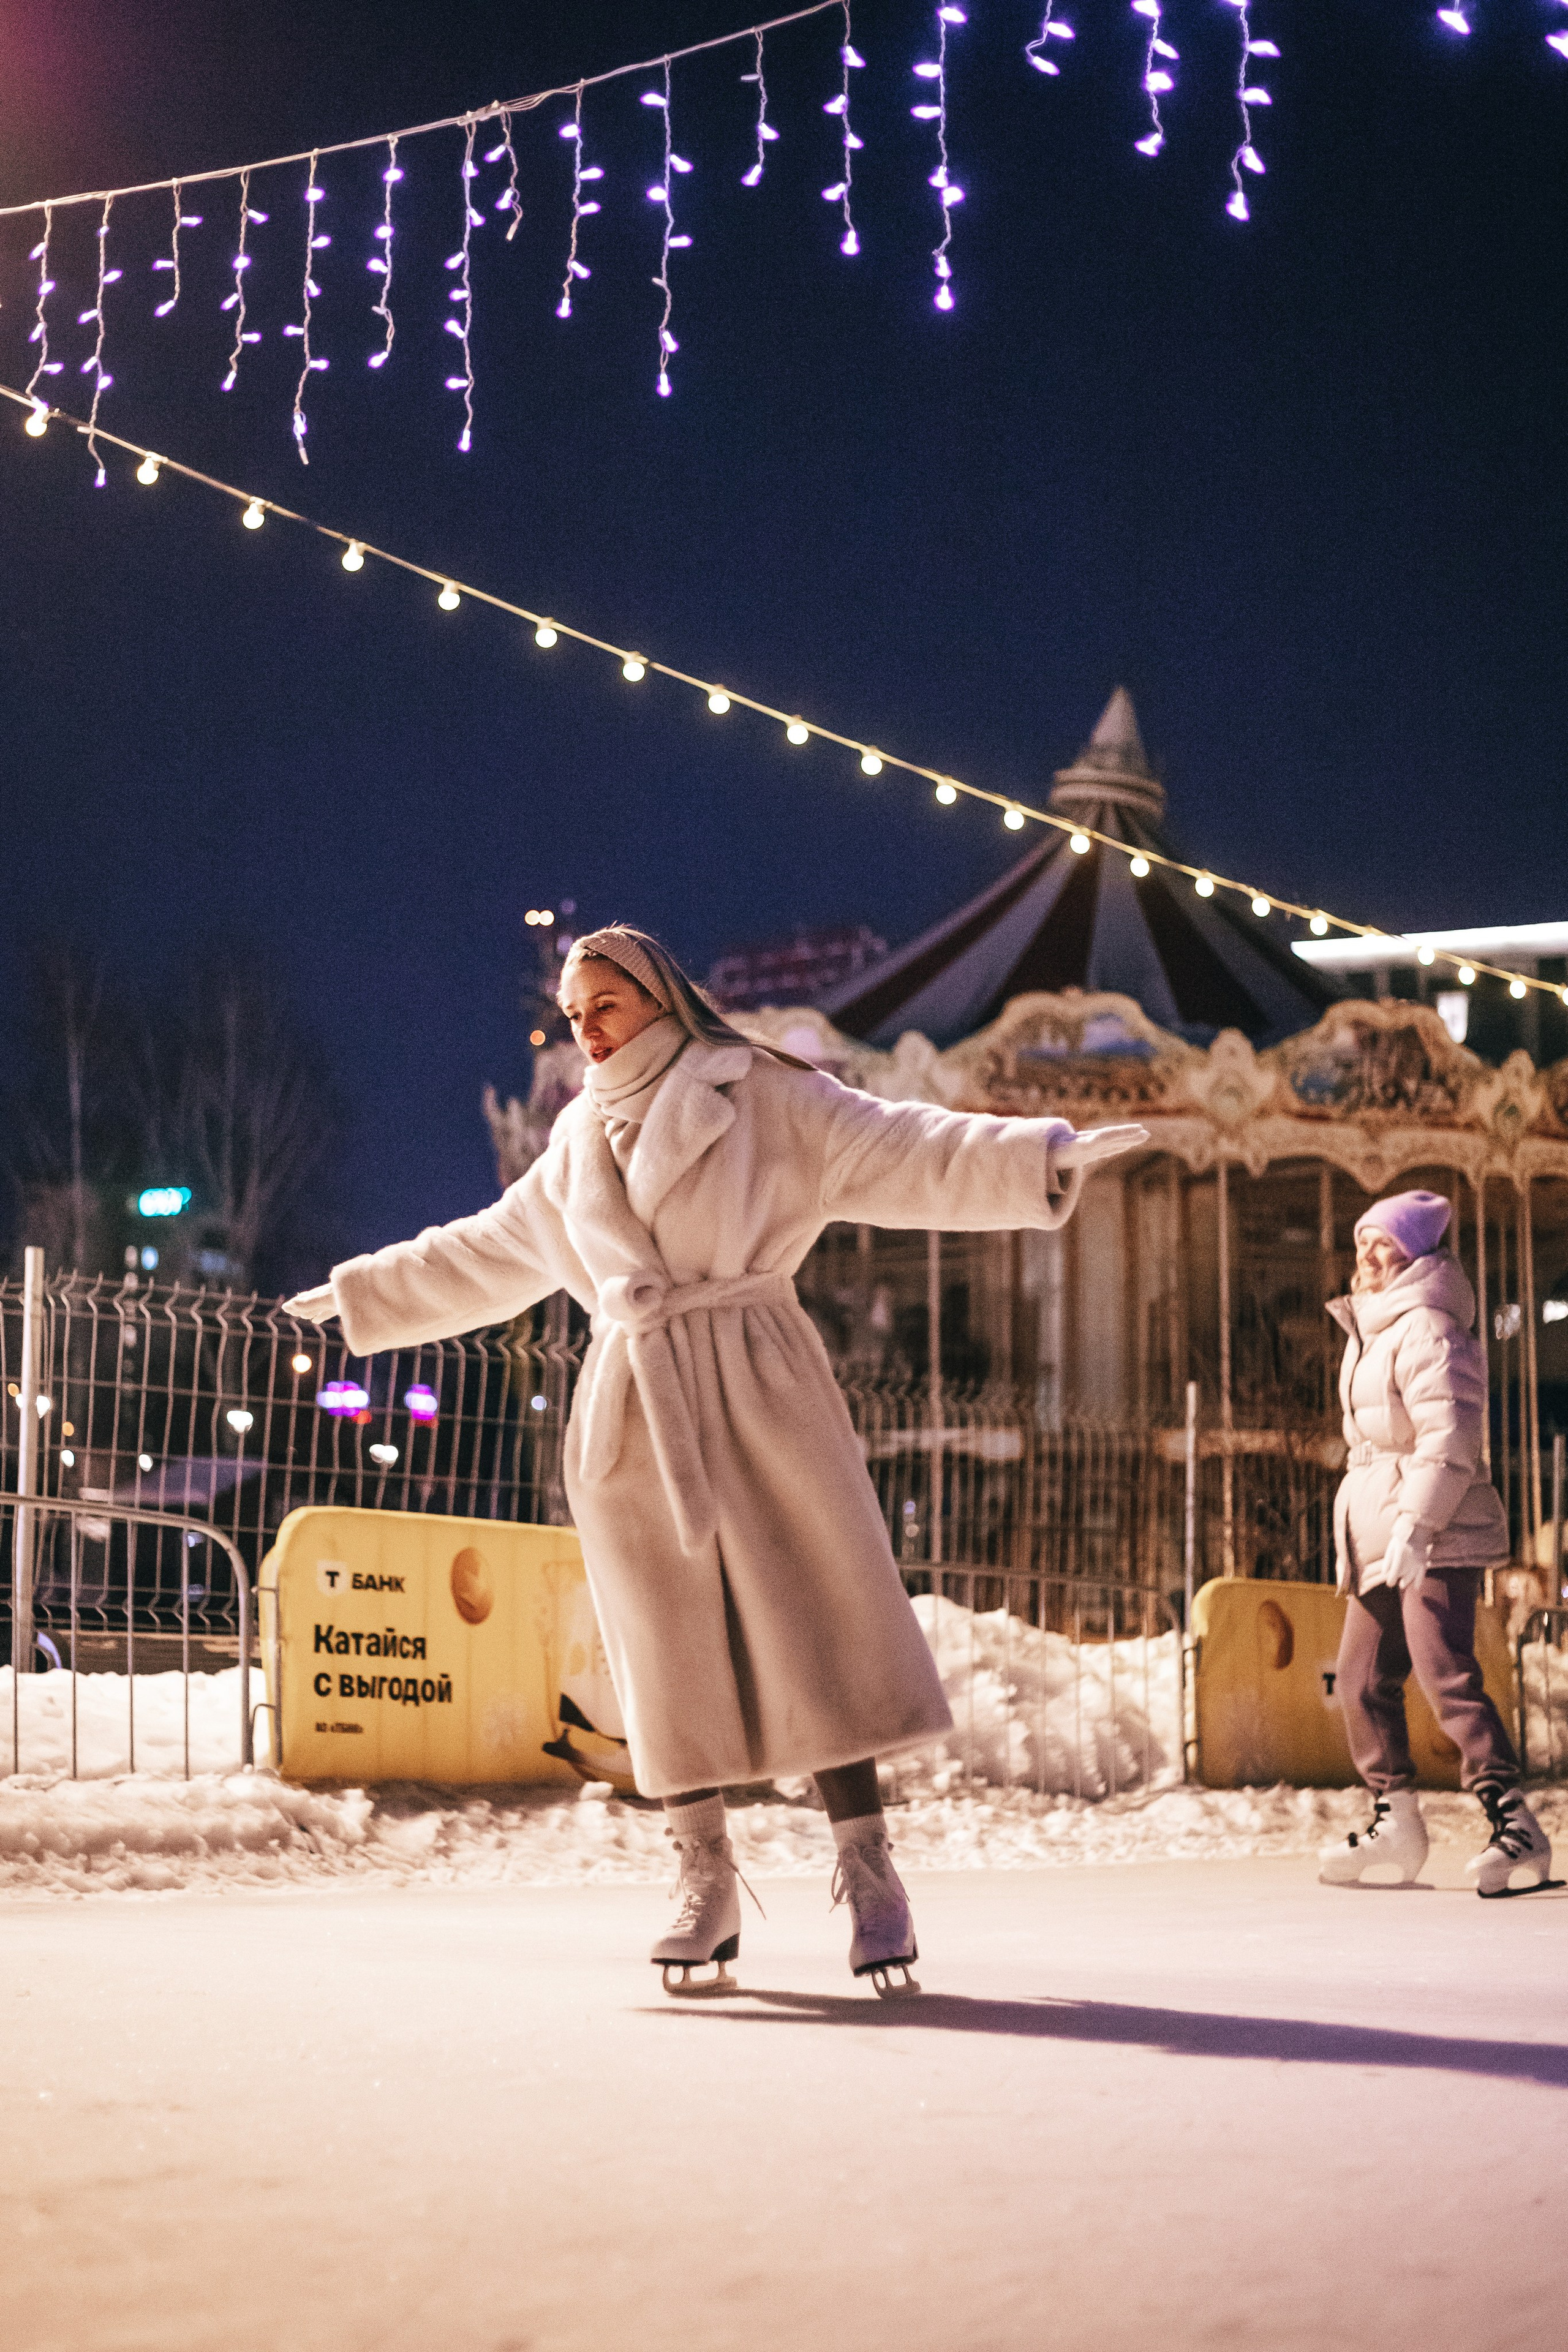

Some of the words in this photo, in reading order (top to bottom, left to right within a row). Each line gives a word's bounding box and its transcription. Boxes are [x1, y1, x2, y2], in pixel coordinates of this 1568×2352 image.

[352, 1572, 406, 1593] БАНК
[314, 1624, 427, 1660] Катайся
[314, 1672, 333, 1697] с
[339, 1673, 453, 1707] выгодой
